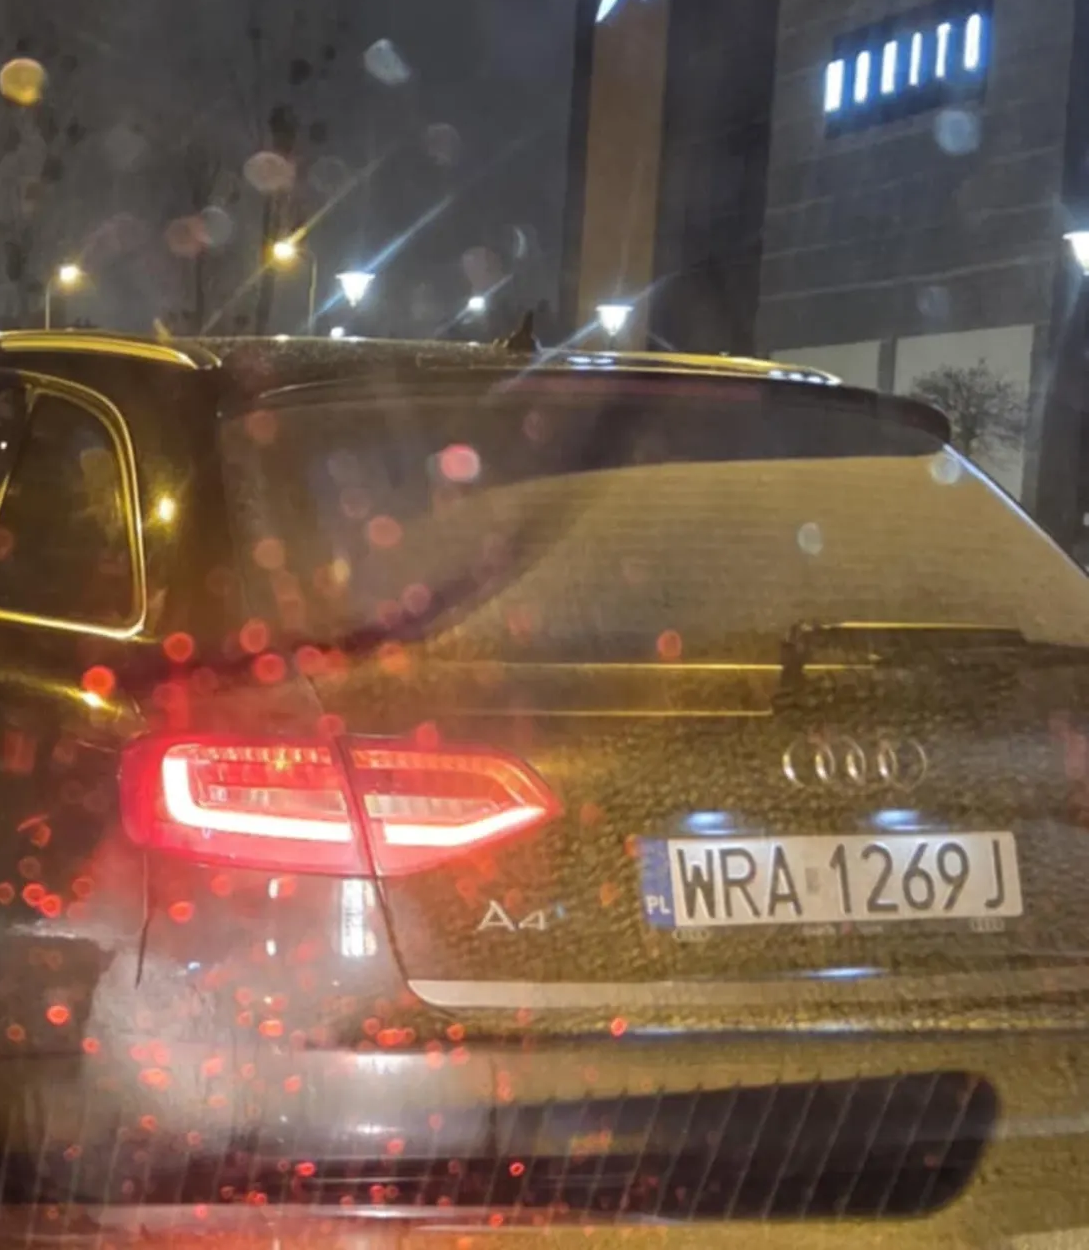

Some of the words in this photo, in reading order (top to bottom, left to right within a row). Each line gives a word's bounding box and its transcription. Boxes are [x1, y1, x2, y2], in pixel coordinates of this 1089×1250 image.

[677, 844, 802, 919] WRA
[828, 839, 1006, 915] 1269J
[477, 899, 547, 932] A4
[646, 895, 671, 915] PL
